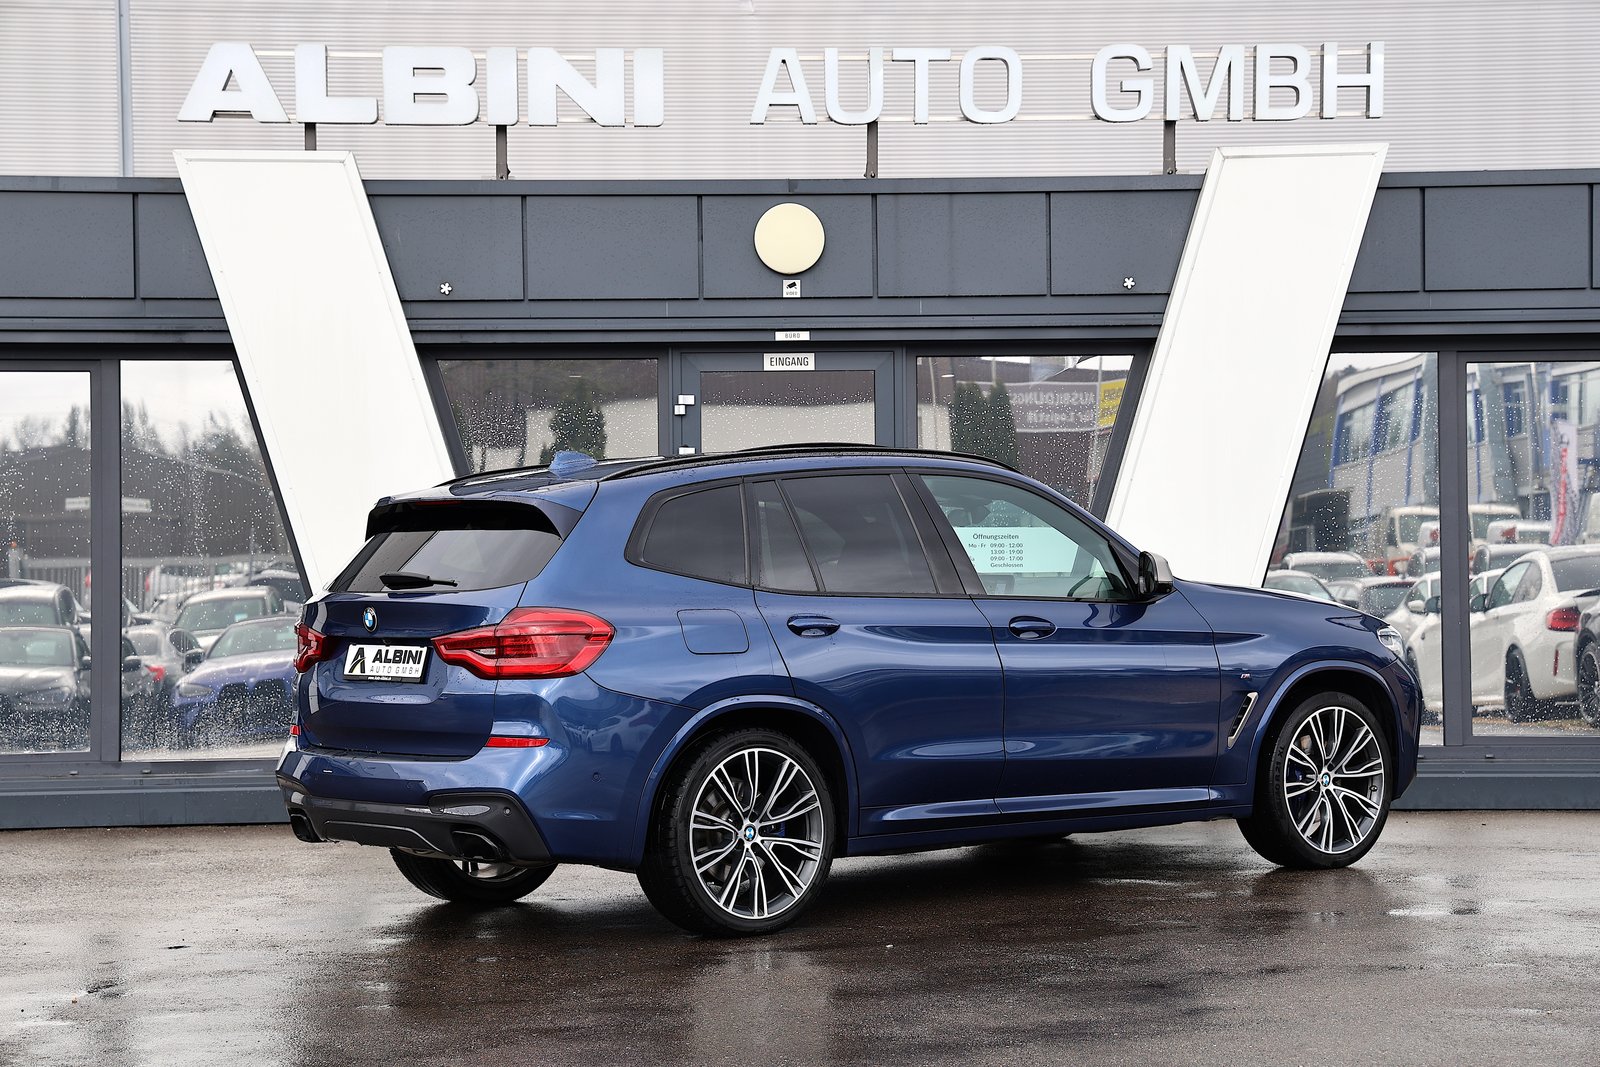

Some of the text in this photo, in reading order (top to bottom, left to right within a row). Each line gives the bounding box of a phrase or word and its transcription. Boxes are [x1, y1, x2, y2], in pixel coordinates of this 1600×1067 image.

[177, 41, 1386, 127] ALBINI AUTO GMBH
[770, 357, 809, 366] EINGANG
[372, 648, 423, 664] ALBINI
[370, 666, 420, 674] AUTO GMBH
